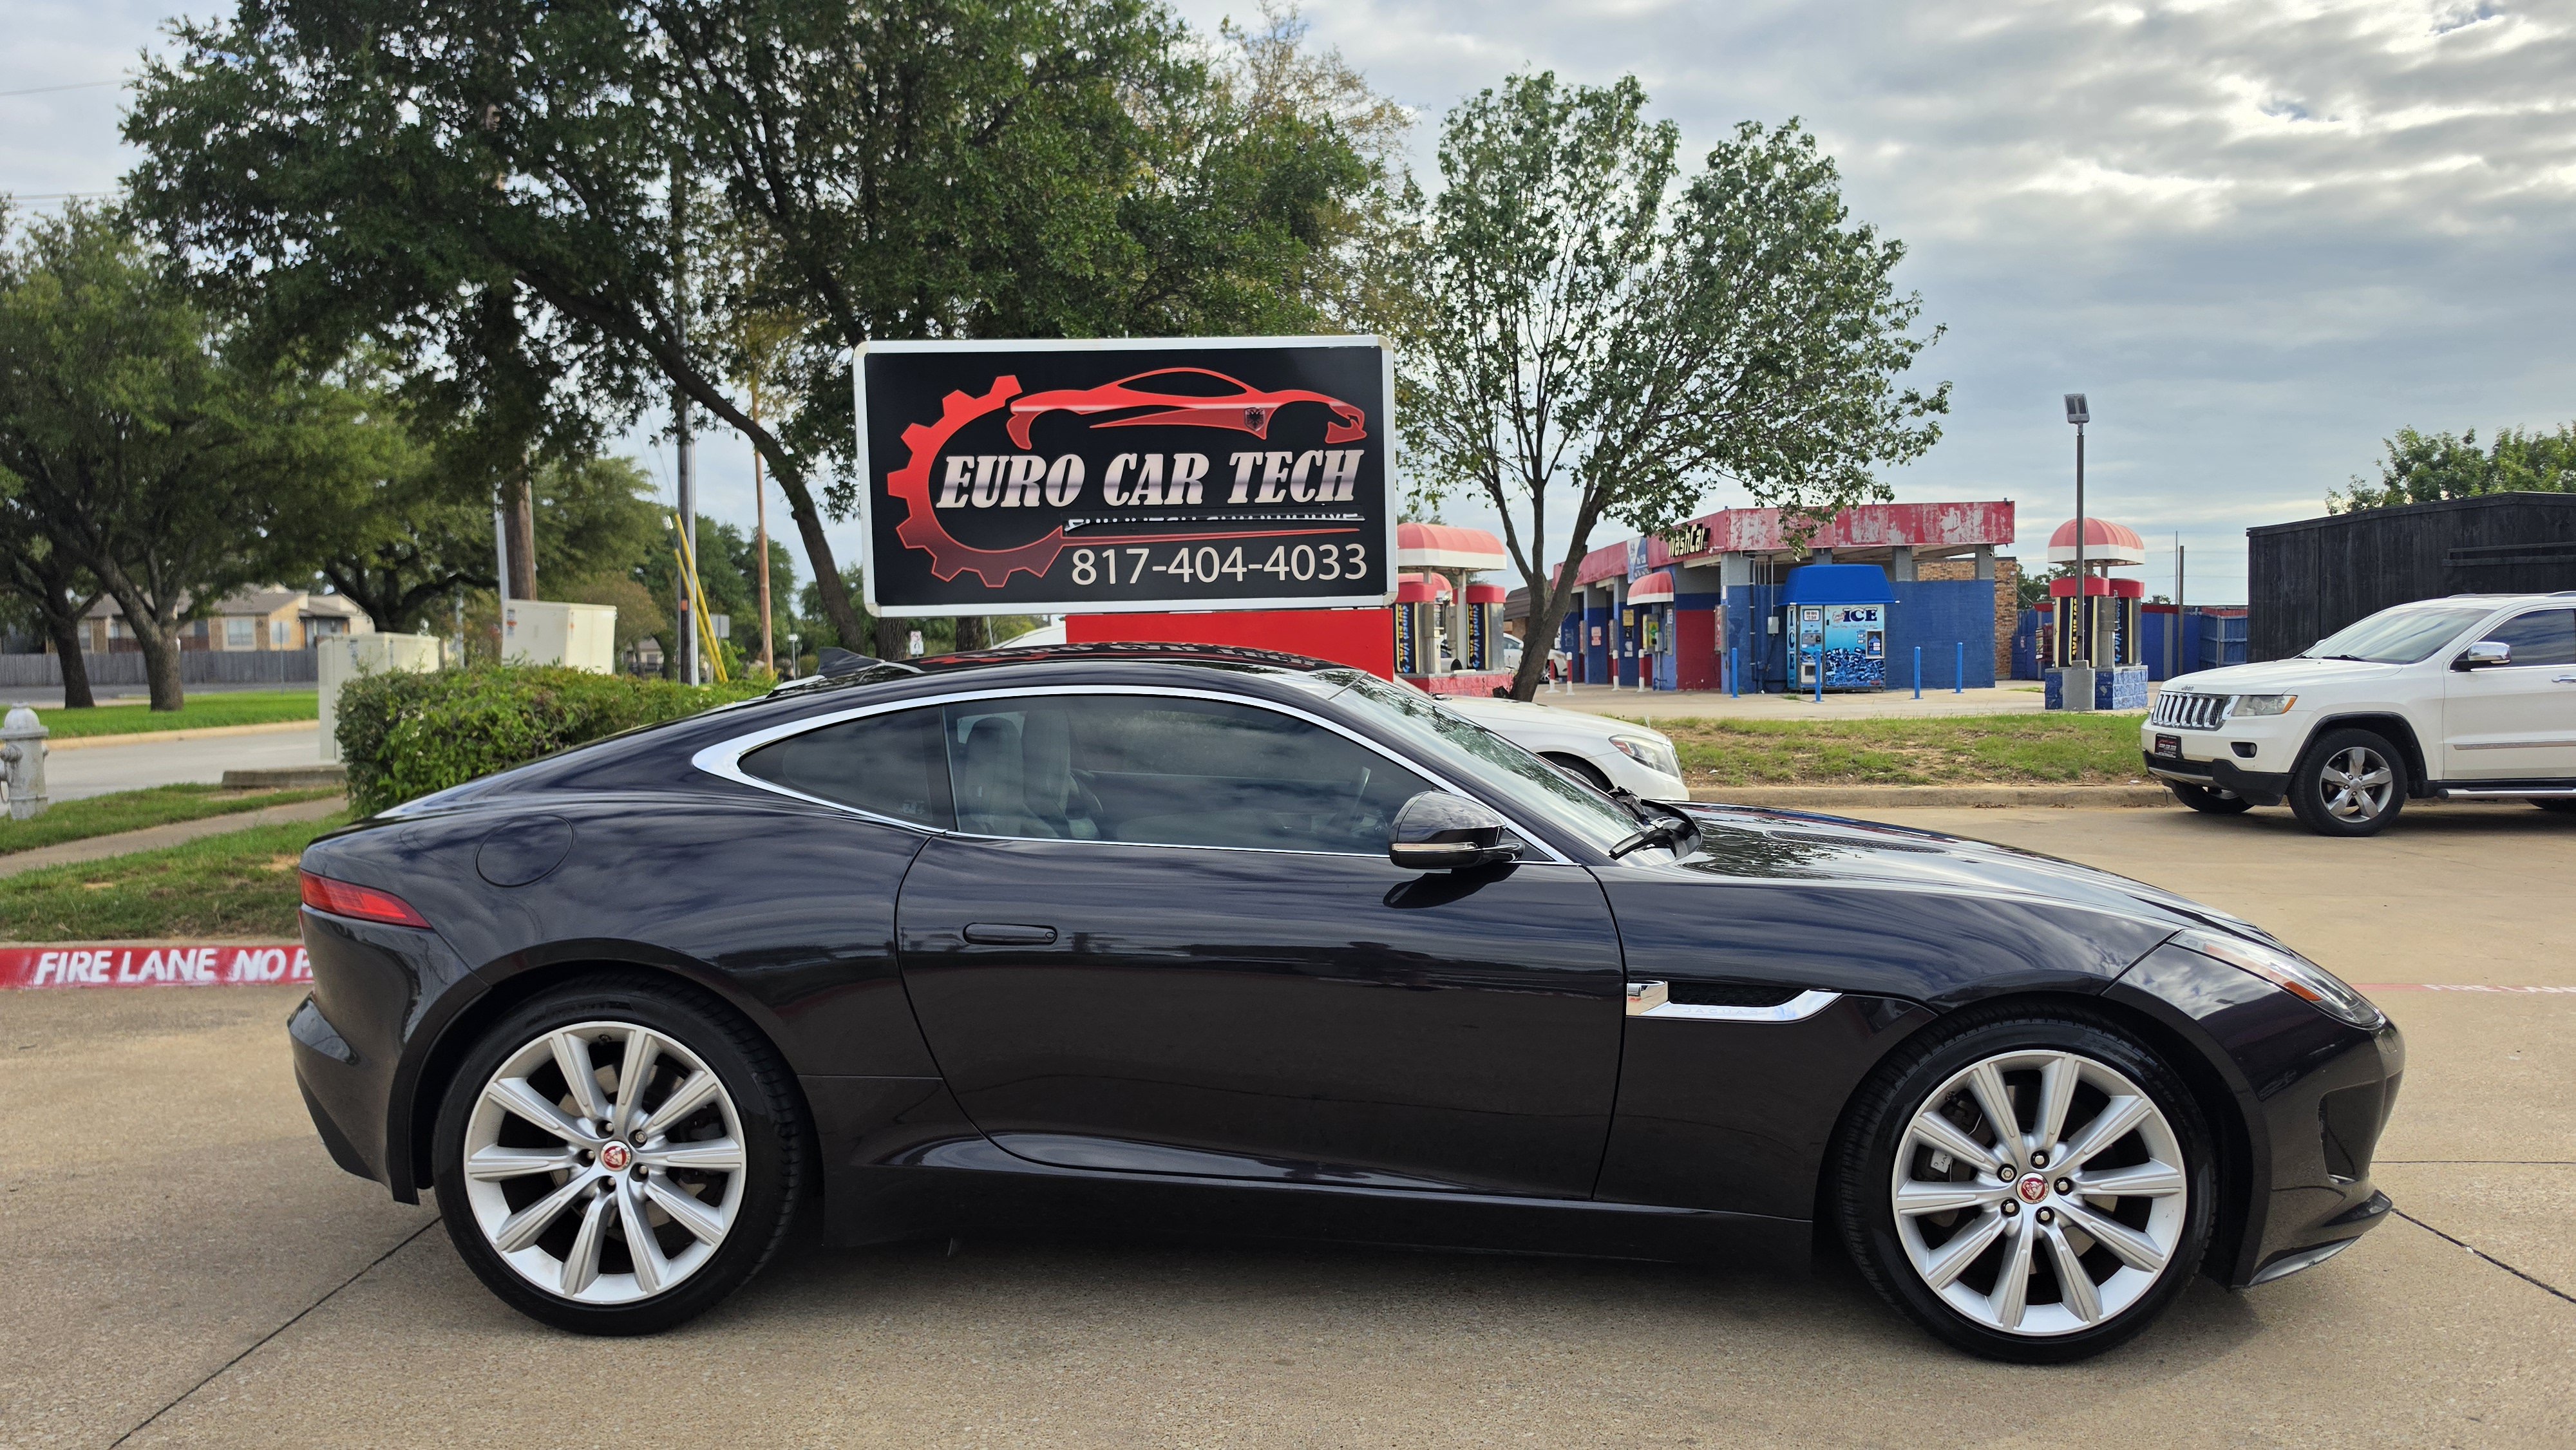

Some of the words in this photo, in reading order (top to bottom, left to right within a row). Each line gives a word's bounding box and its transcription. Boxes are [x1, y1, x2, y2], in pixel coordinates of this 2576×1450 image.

[936, 452, 1085, 509] EURO
[1103, 452, 1209, 506] CAR
[1227, 449, 1365, 504] TECH
[1072, 543, 1368, 586] 817-404-4033
[1842, 607, 1878, 622] ICE
[33, 950, 113, 986] FIRE
[117, 948, 219, 983] LANE
[231, 948, 287, 979] NO
